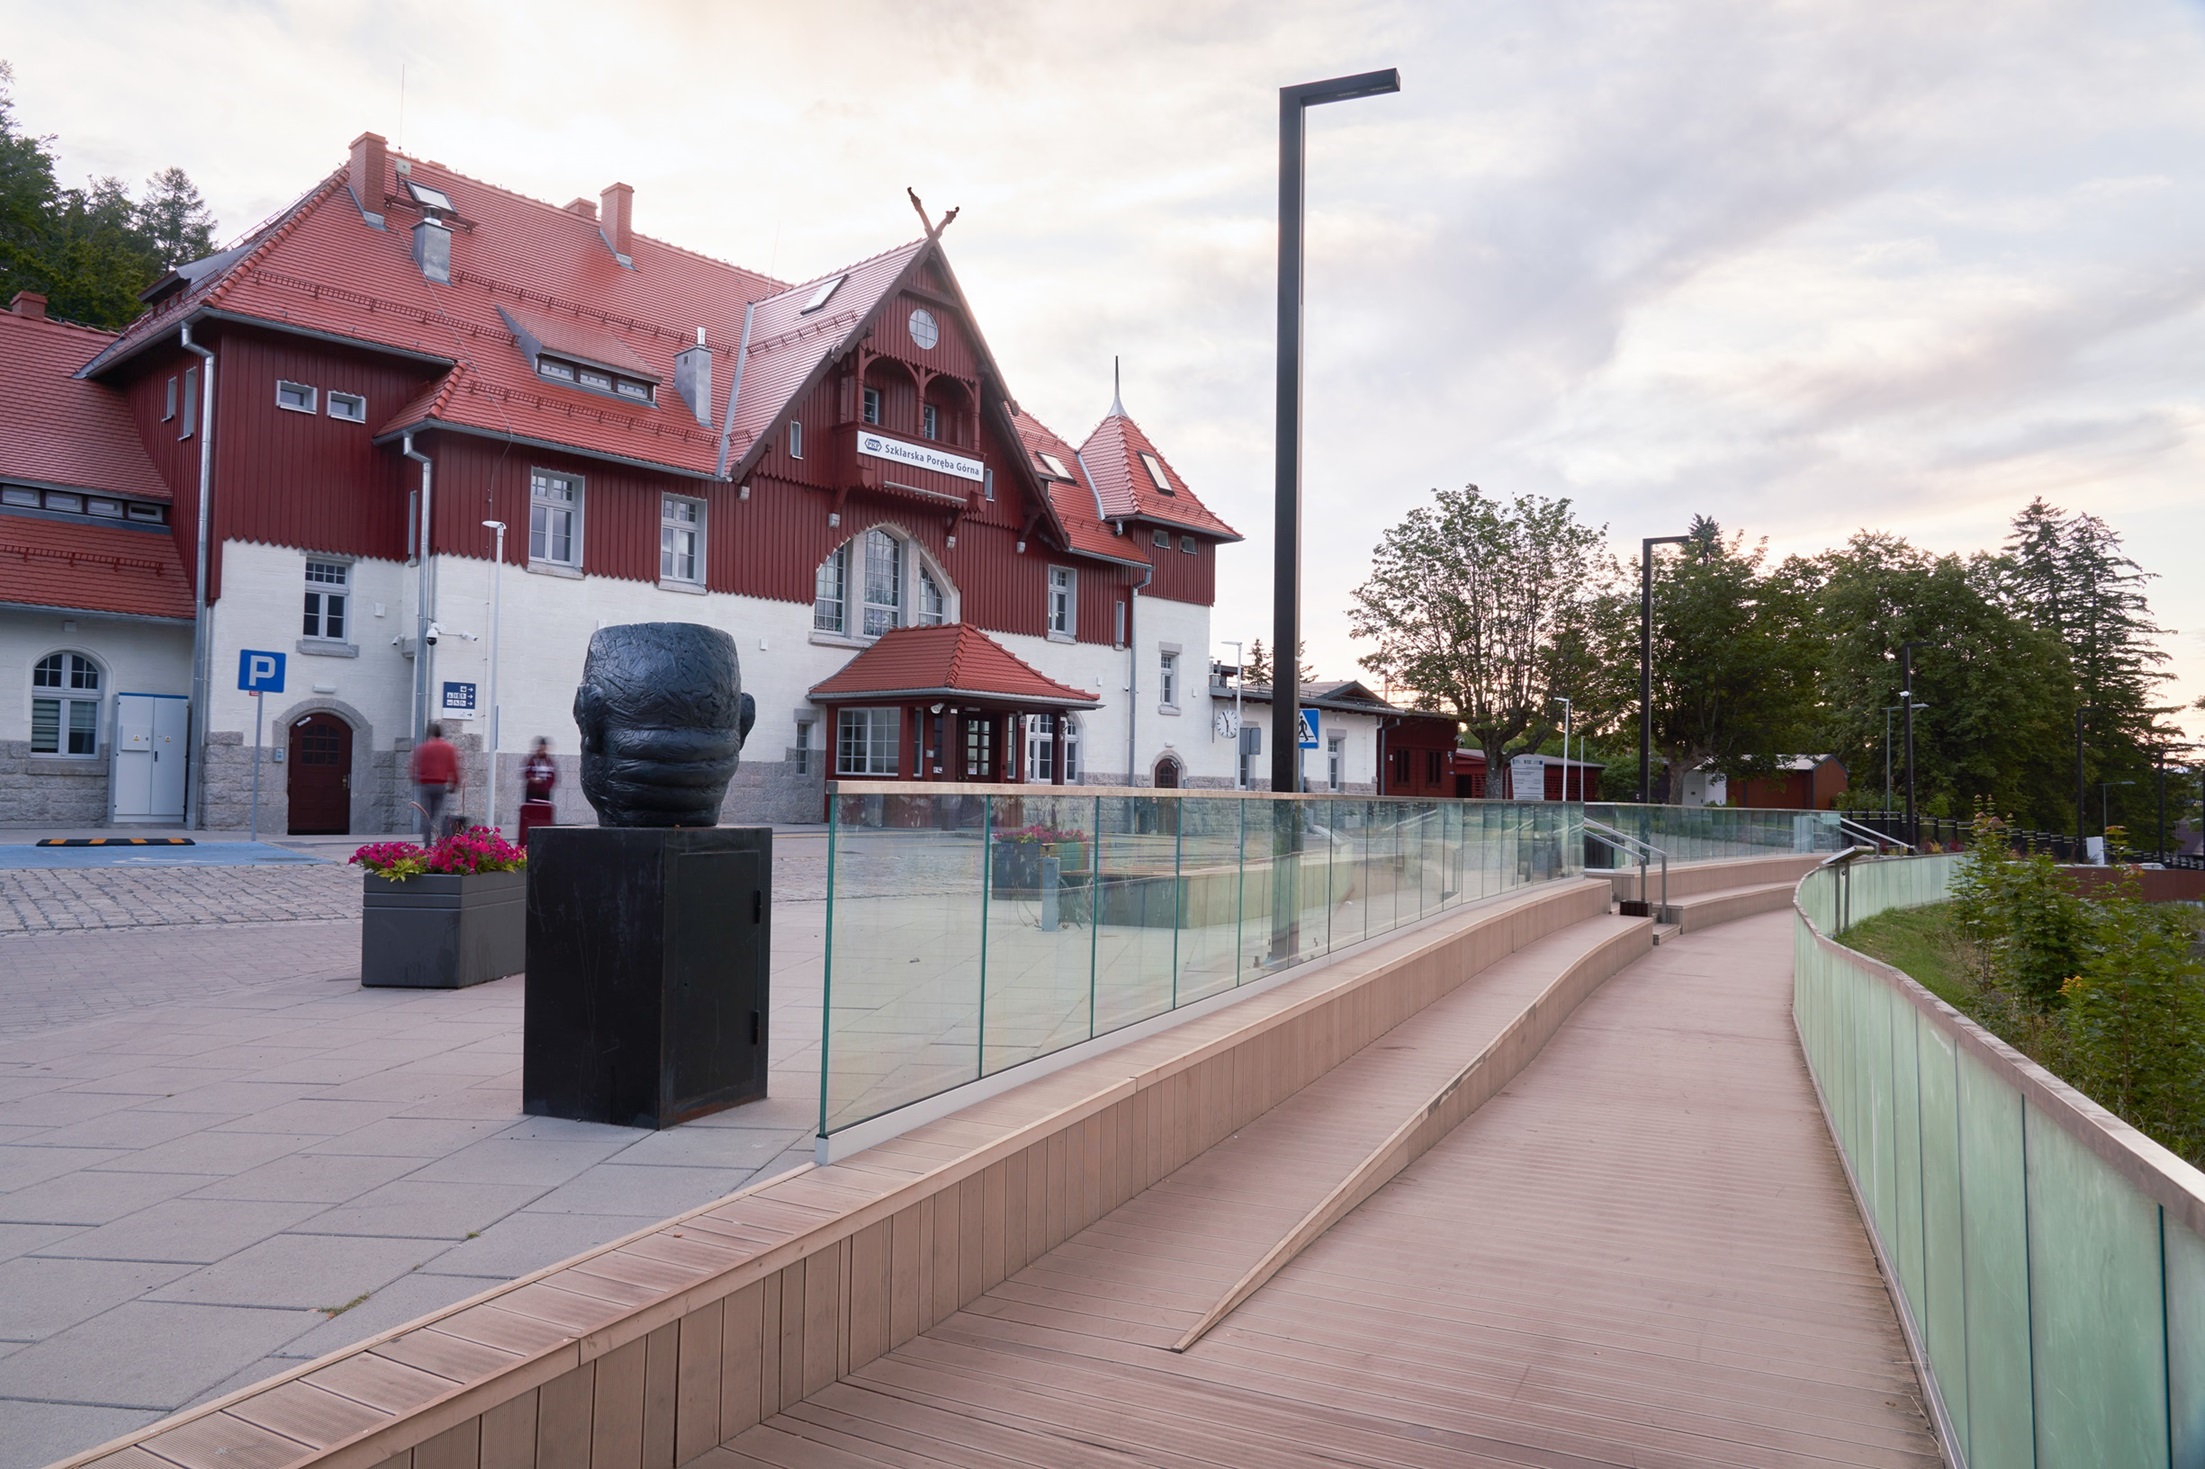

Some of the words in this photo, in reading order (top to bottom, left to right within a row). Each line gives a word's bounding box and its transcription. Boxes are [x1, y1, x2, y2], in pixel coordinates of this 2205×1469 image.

[885, 444, 925, 462] Szklarska
[926, 454, 954, 470] Poręba
[956, 462, 980, 476] Górna
[248, 655, 276, 686] P
